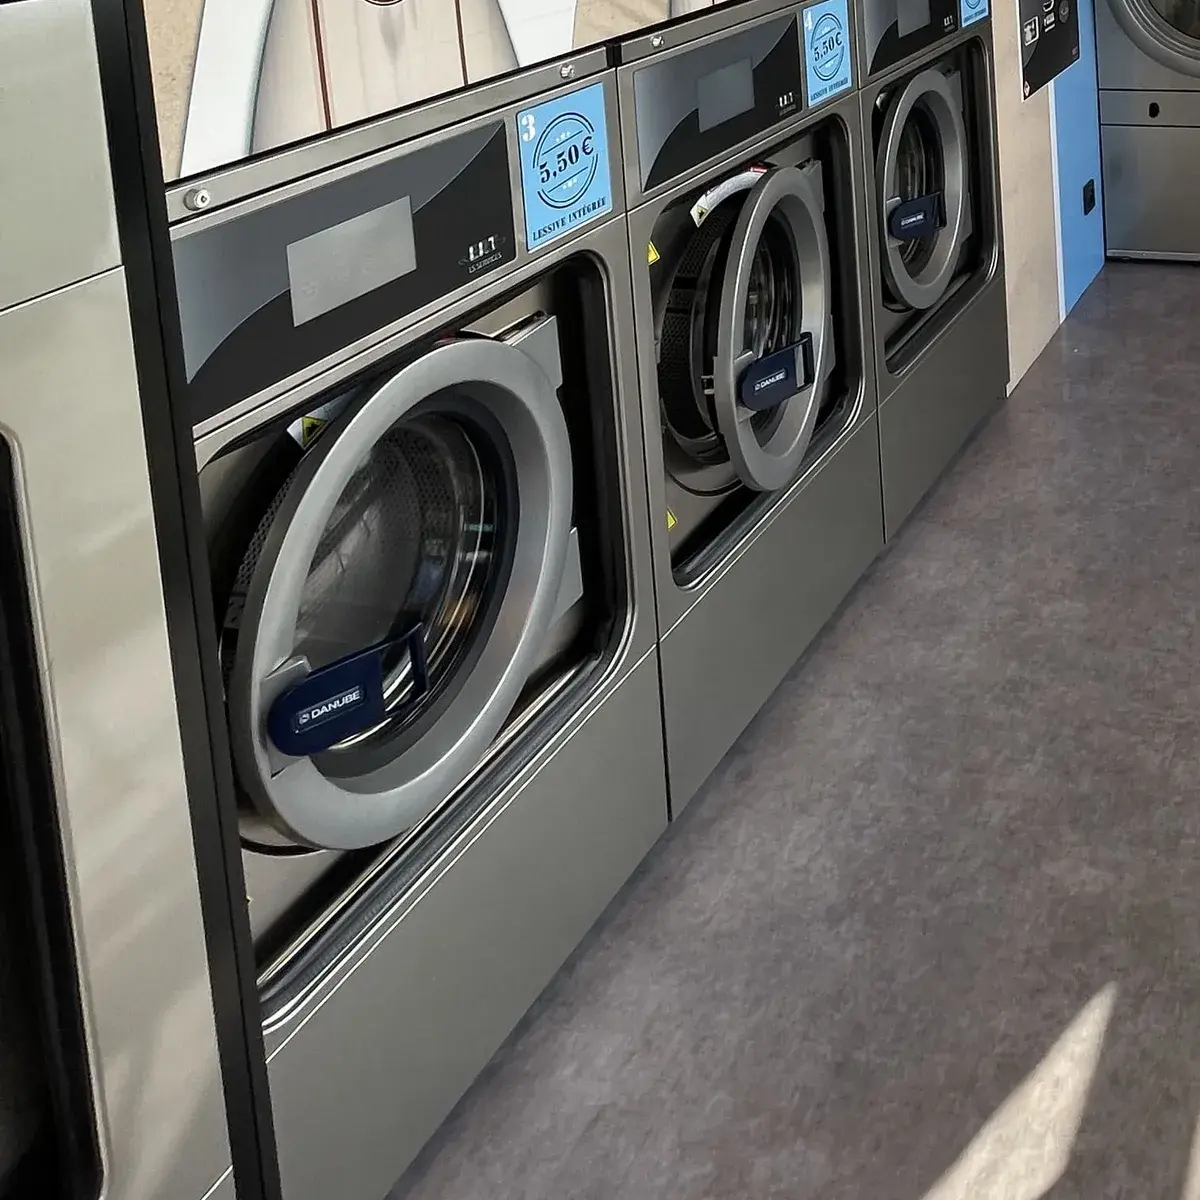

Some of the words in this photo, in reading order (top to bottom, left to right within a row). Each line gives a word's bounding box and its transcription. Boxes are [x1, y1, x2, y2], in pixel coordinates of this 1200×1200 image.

[804, 11, 813, 30] 4
[521, 113, 536, 142] 3
[532, 216, 567, 242] LESSIVE
[568, 197, 606, 224] INTÉGRÉE
[311, 690, 360, 720] DANUBE
